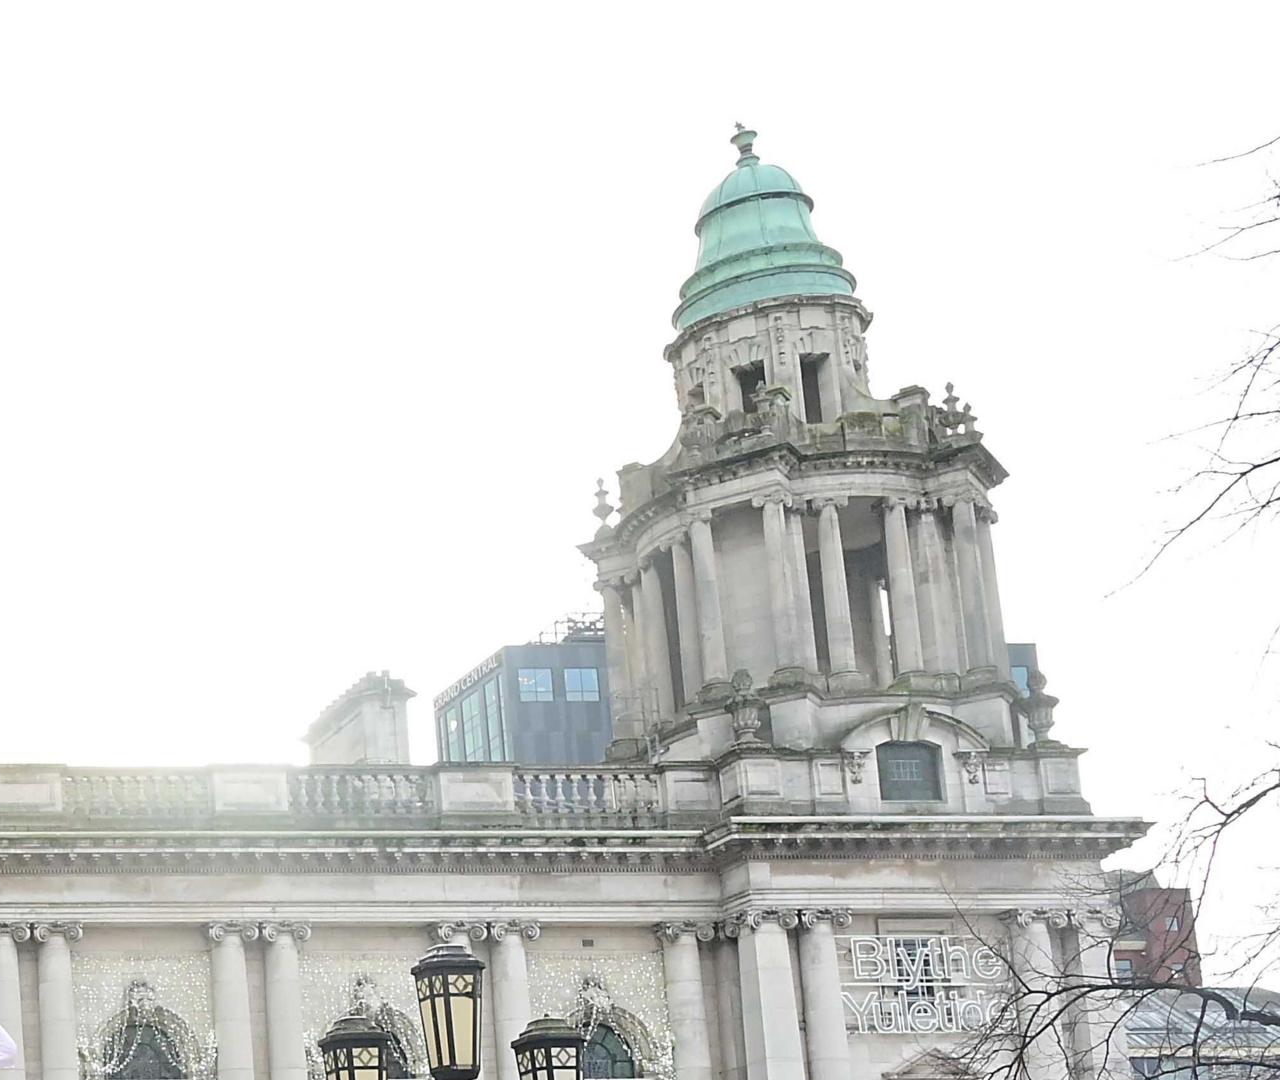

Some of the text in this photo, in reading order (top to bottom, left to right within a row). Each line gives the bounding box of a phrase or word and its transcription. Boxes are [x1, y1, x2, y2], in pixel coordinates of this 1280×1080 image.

[433, 655, 498, 711] GRAND CENTRAL
[851, 937, 1002, 990] Blythe
[840, 990, 1017, 1033] Yuletide
